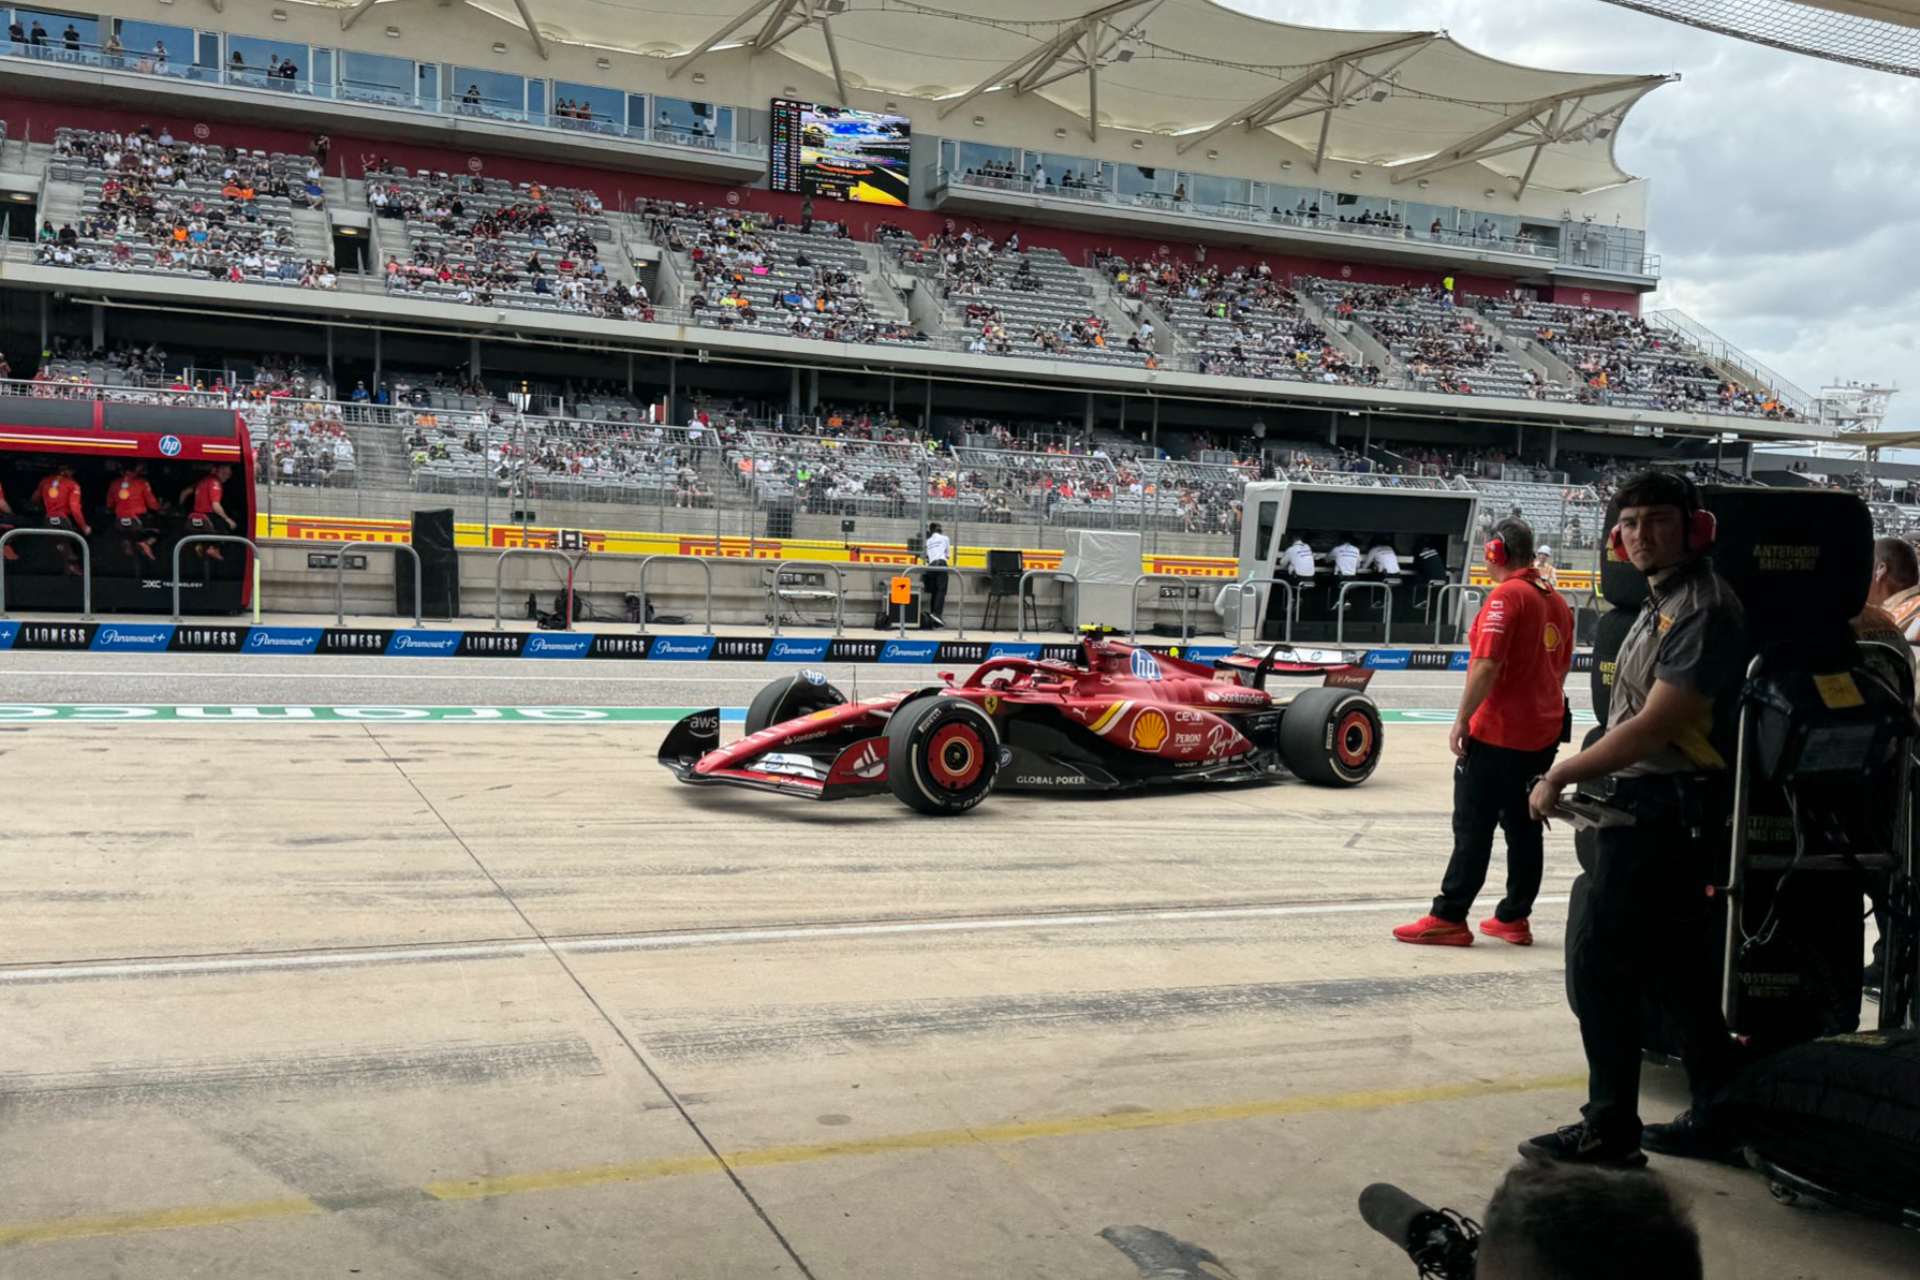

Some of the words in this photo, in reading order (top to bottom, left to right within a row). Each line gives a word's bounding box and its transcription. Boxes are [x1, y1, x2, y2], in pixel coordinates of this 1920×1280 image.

[161, 436, 180, 456] hp
[25, 628, 86, 643] LIONESS
[100, 629, 166, 645] Paramount+
[179, 630, 237, 645] LIONESS
[251, 632, 314, 647] Paramount+
[327, 633, 382, 648] LIONESS
[395, 635, 455, 650] Paramount+
[466, 636, 518, 650] LIONESS
[529, 637, 586, 652] Paramount+
[596, 639, 645, 652] LIONESS
[656, 640, 707, 655] Paramount+
[718, 642, 764, 655] LIONESS
[774, 643, 823, 657] Paramount+
[833, 644, 876, 656] LIONESS
[885, 644, 932, 658] Paramount+
[941, 646, 982, 659] LIONESS
[1044, 648, 1077, 661] LIONES
[1133, 649, 1158, 680] hp
[690, 716, 718, 729] aws
[1016, 776, 1054, 784] GLOBAL
[1056, 776, 1086, 785] POKER
